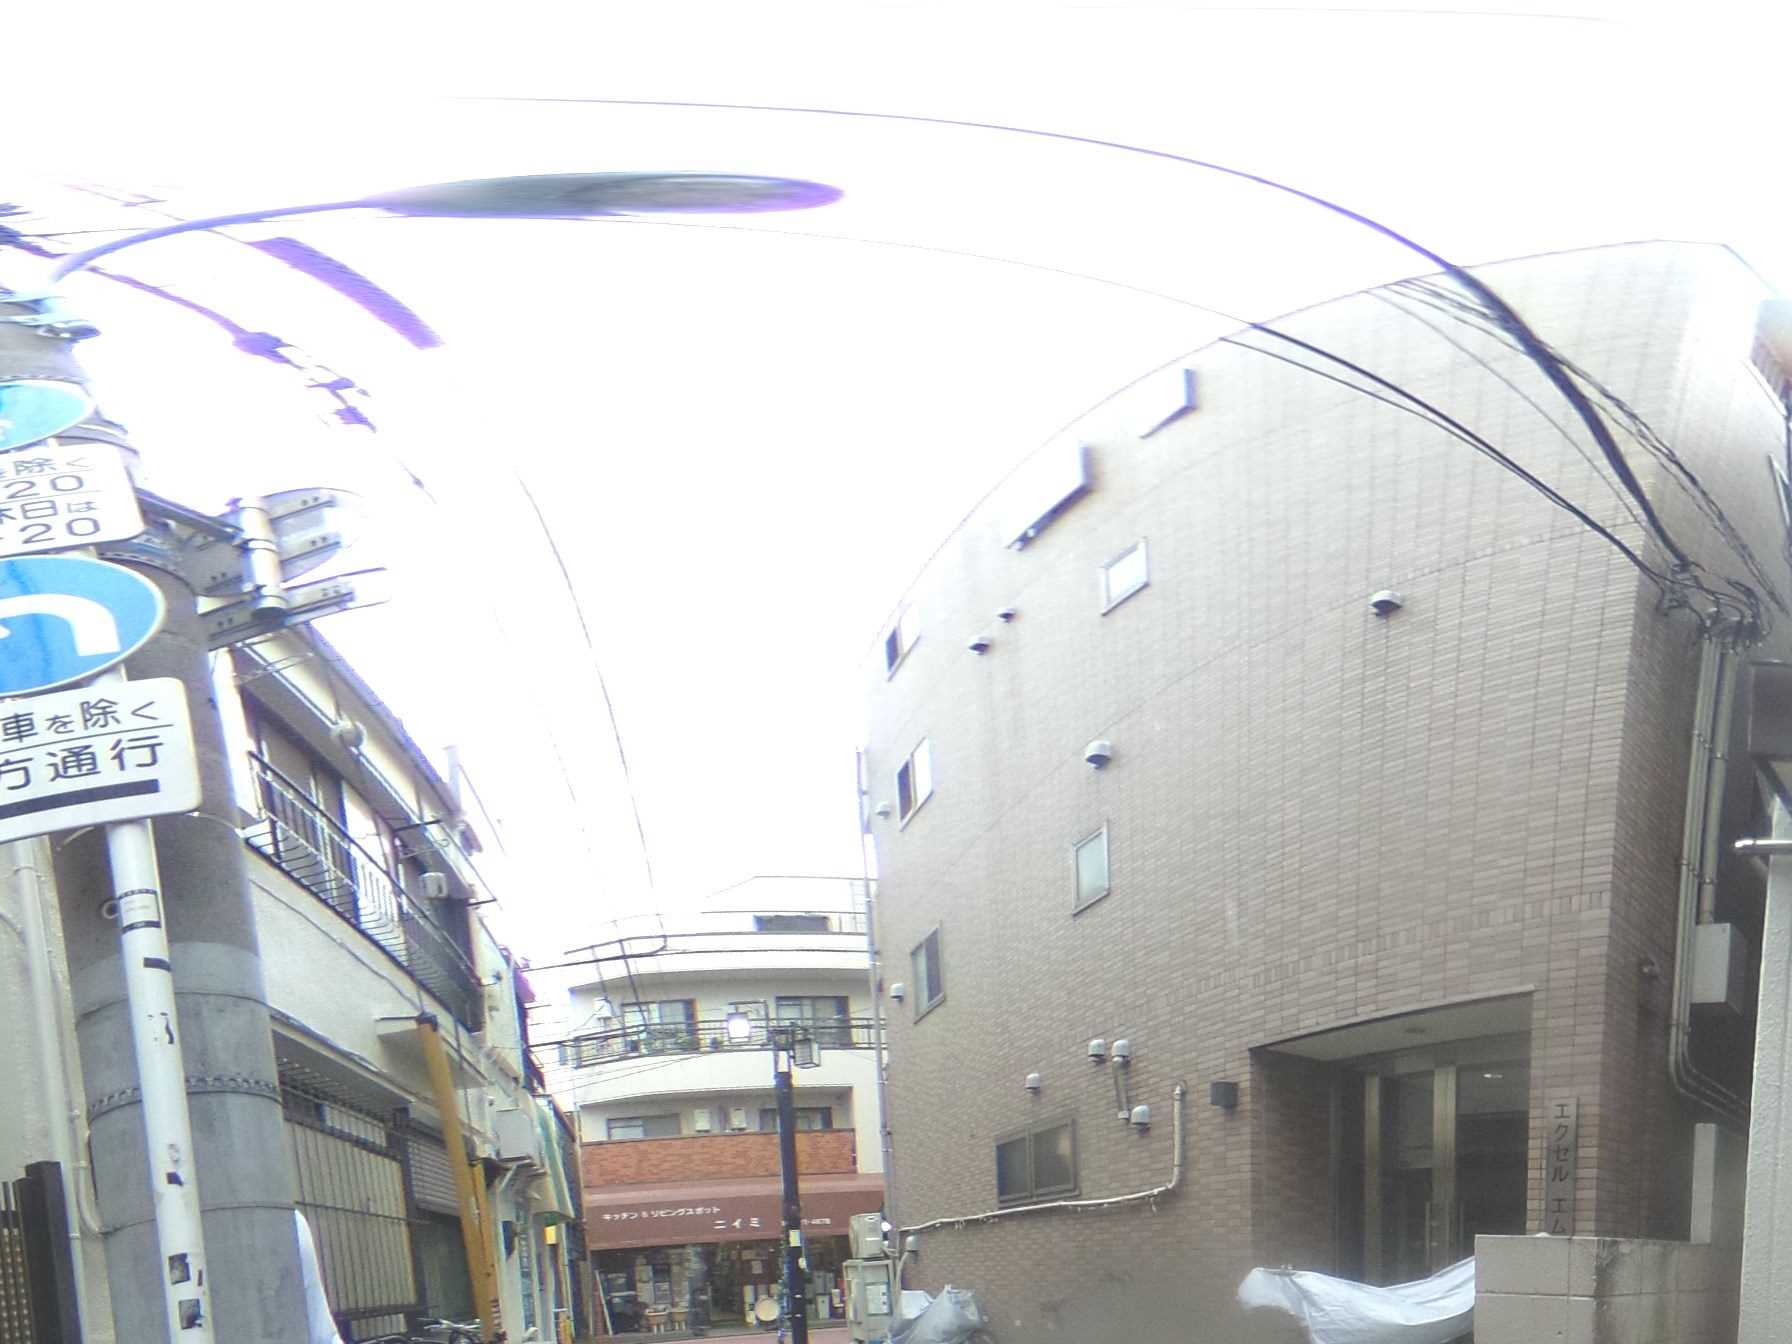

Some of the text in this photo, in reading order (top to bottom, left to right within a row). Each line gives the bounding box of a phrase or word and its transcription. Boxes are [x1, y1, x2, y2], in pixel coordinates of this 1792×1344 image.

[1551, 1103, 1571, 1183] エクセル
[713, 1217, 761, 1229] ニイミ
